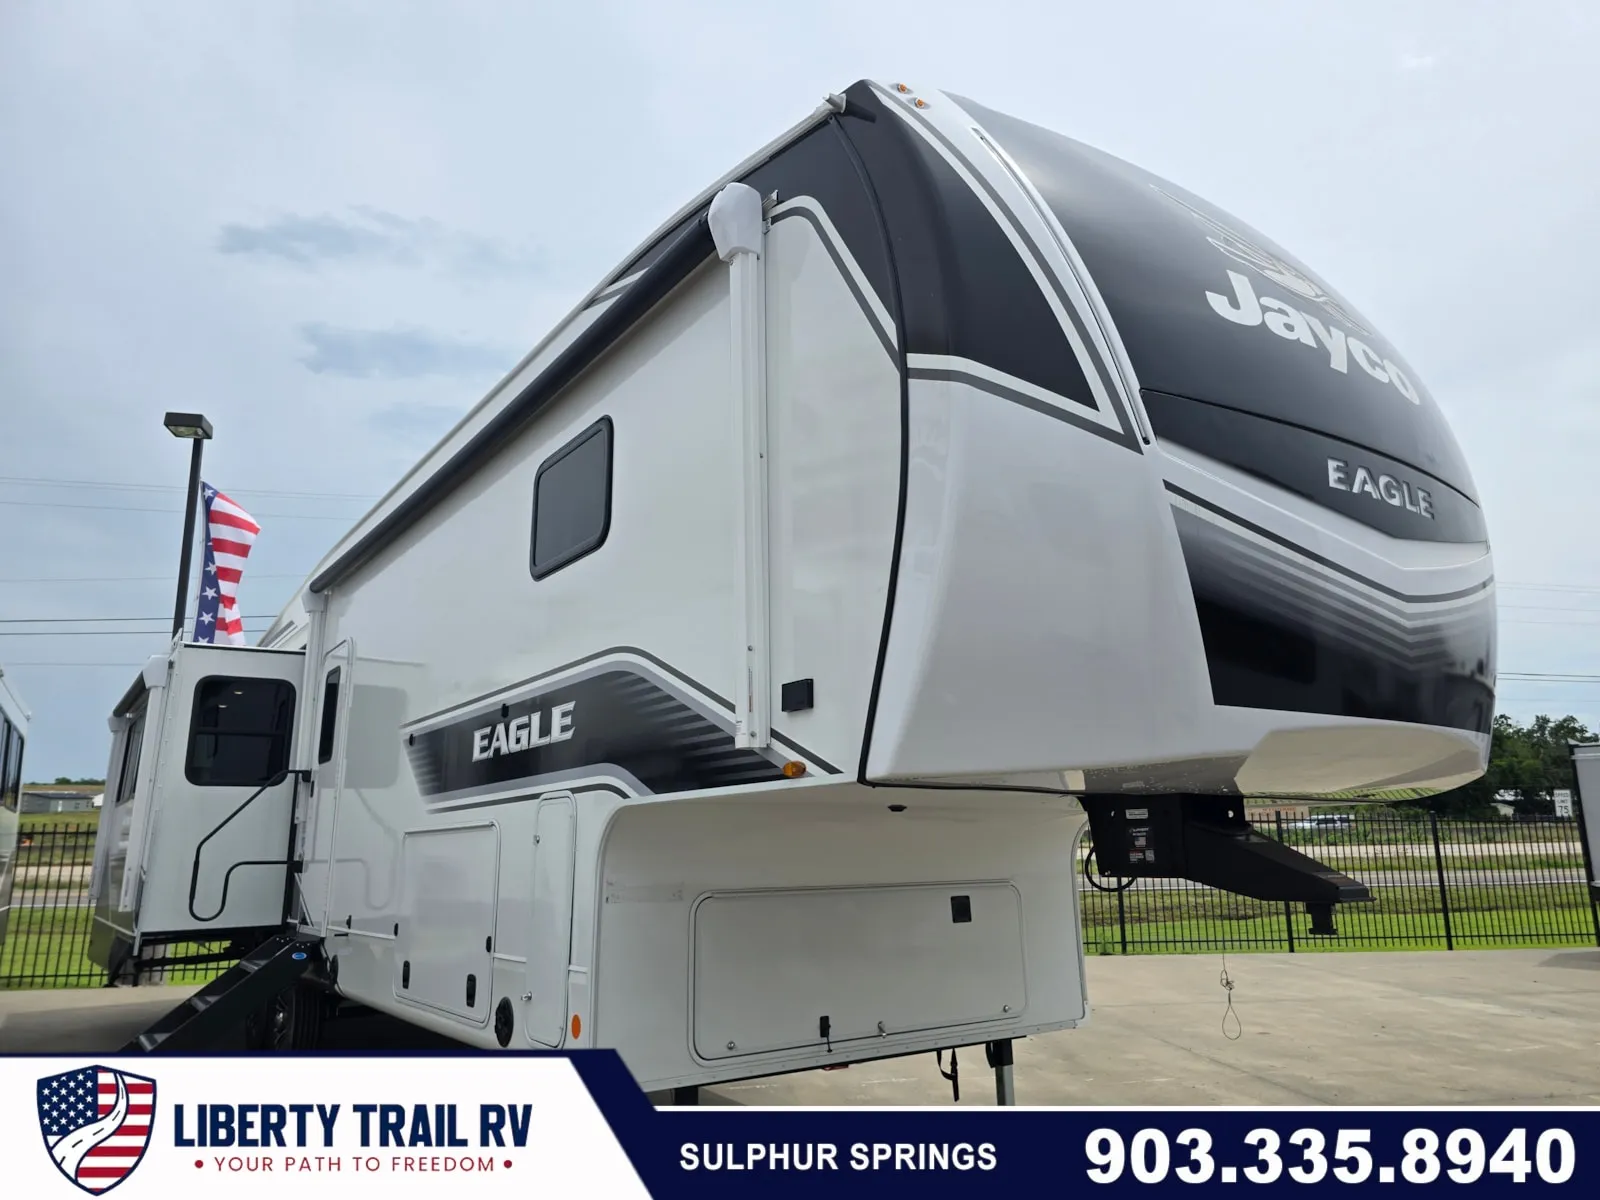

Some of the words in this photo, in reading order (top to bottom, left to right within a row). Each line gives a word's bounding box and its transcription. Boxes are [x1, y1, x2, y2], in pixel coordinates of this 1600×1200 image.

[1205, 269, 1421, 405] Jayco
[1327, 458, 1435, 520] EAGLE
[472, 701, 576, 762] EAGLE
[1557, 805, 1569, 814] 75
